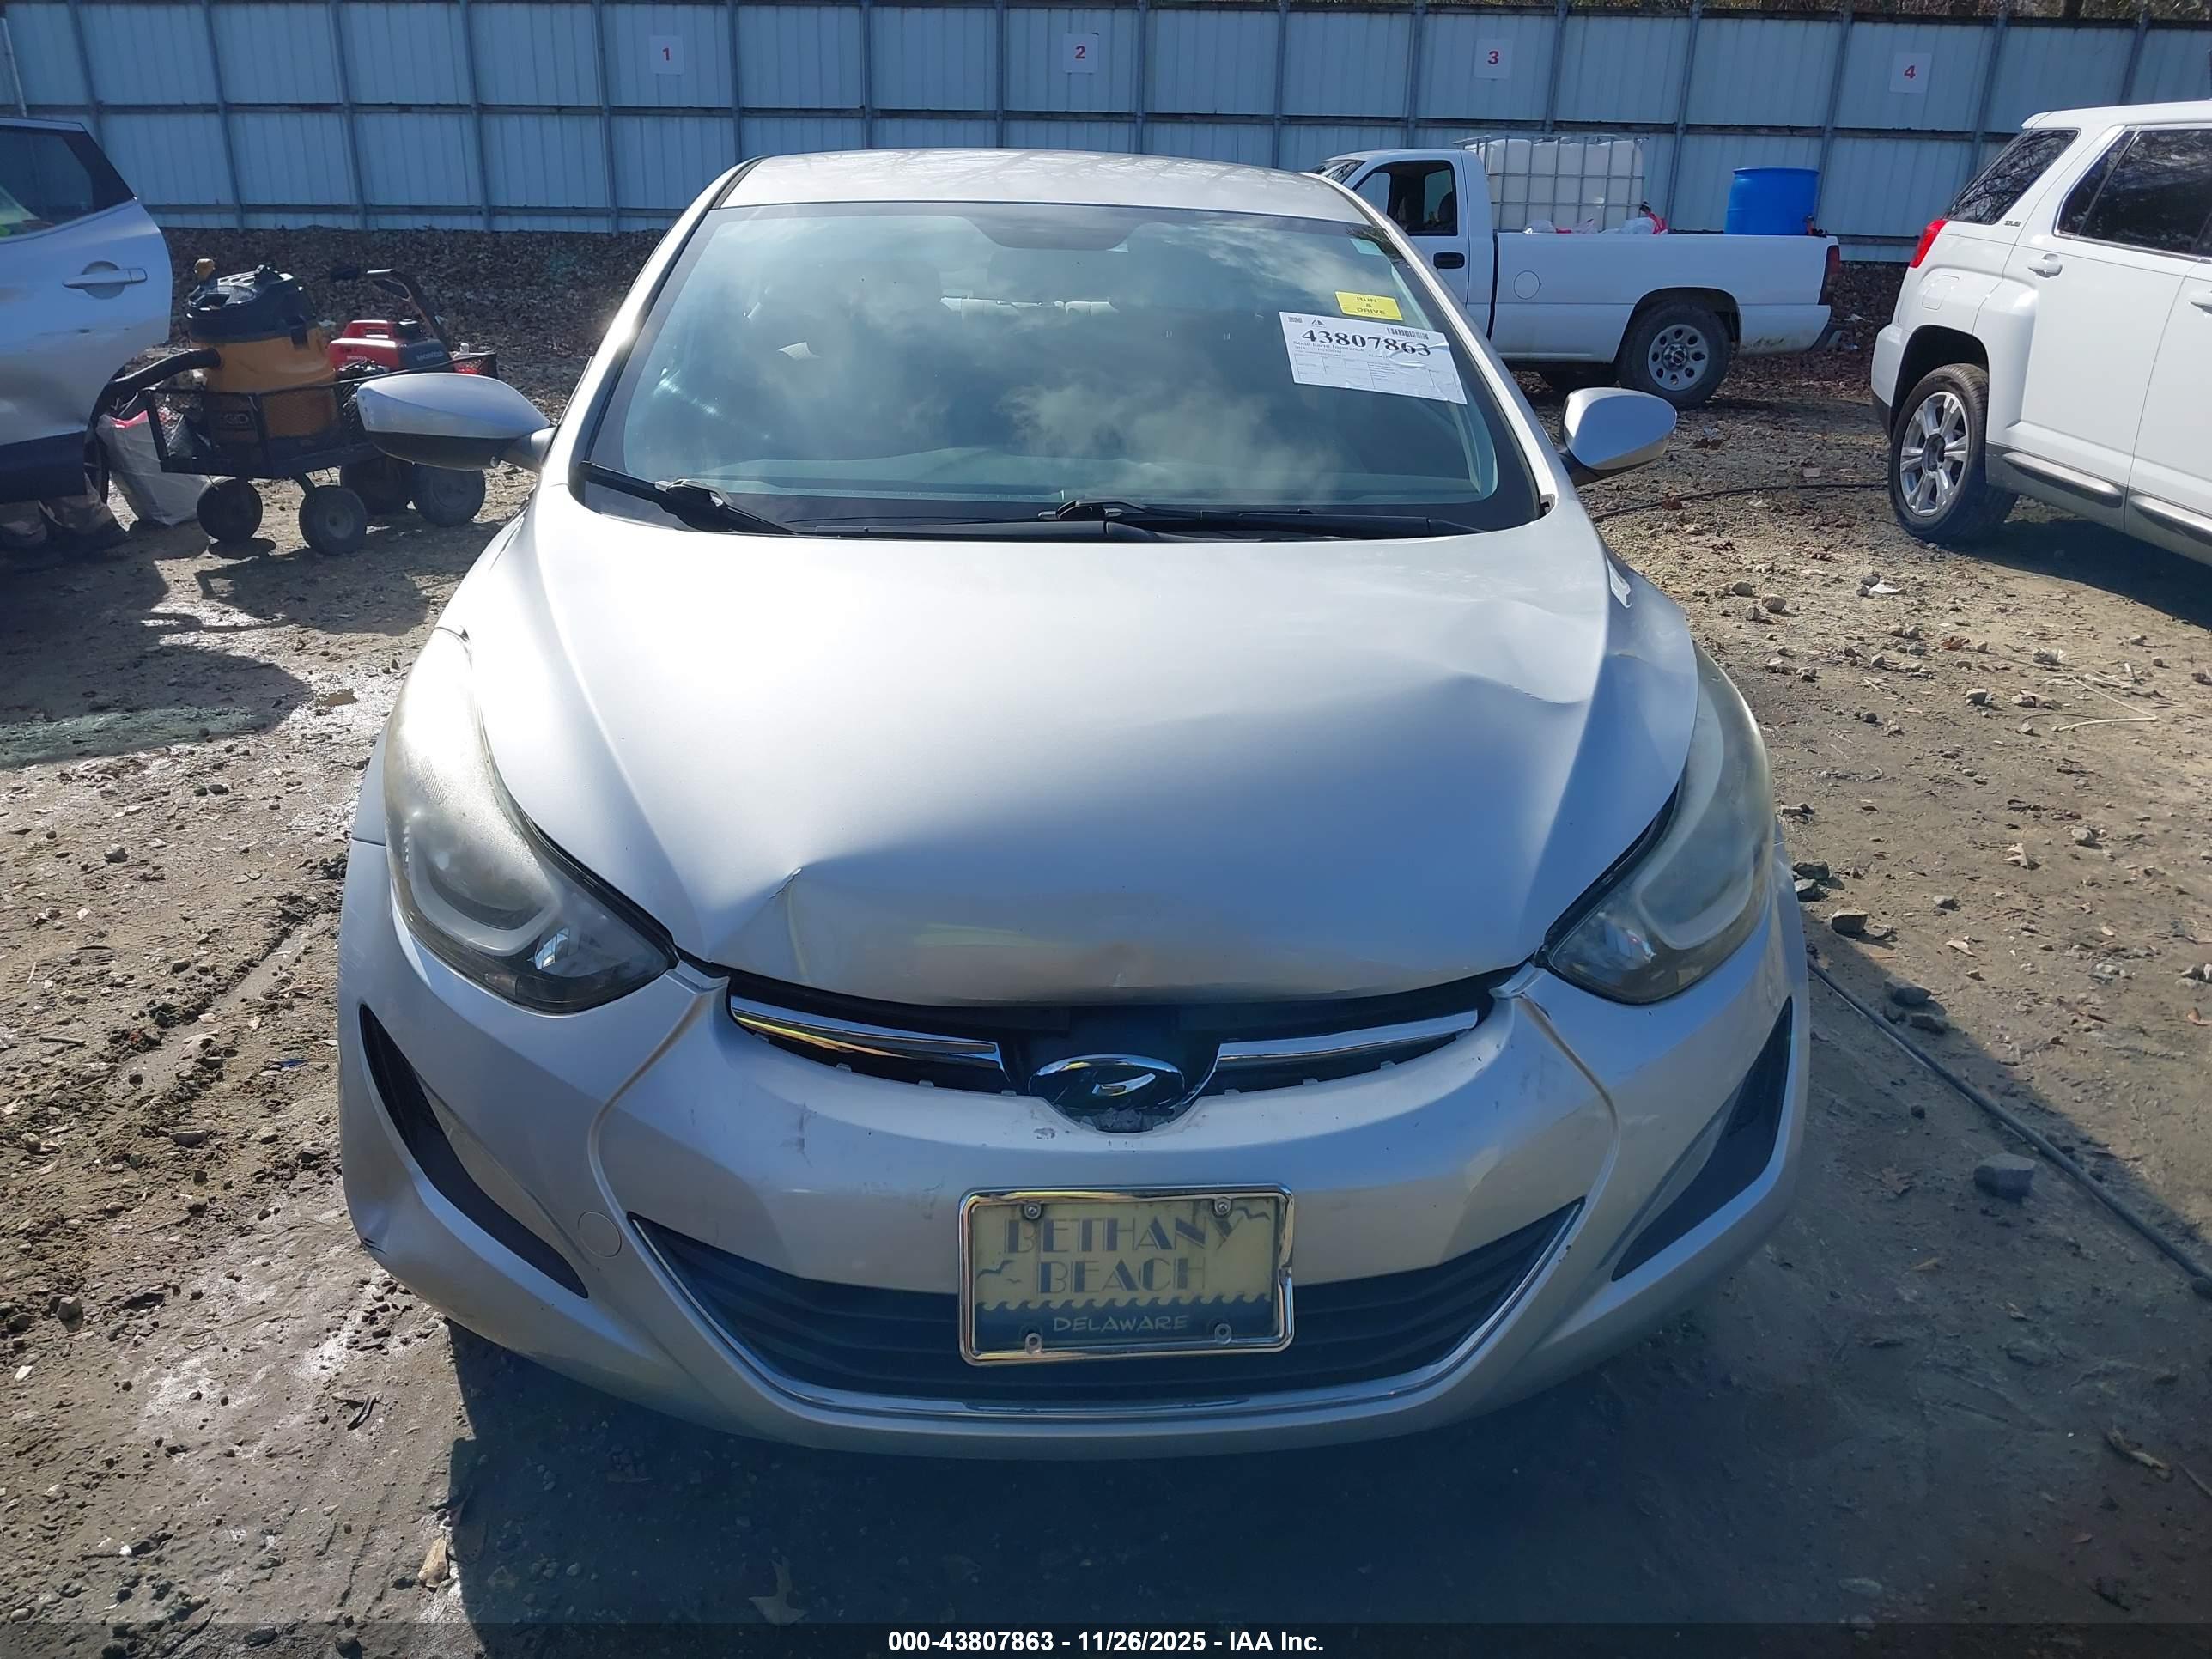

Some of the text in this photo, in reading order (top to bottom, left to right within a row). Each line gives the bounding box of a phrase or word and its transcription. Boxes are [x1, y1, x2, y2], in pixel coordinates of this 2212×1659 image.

[662, 47, 670, 61] 1
[1075, 46, 1085, 59] 2
[1487, 51, 1498, 64] 3
[1904, 65, 1916, 79] 4
[1302, 329, 1431, 356] 43807863
[1004, 1215, 1243, 1253] BETHANY
[1036, 1257, 1206, 1295] BEACH
[1053, 1315, 1190, 1332] DELAWARE
